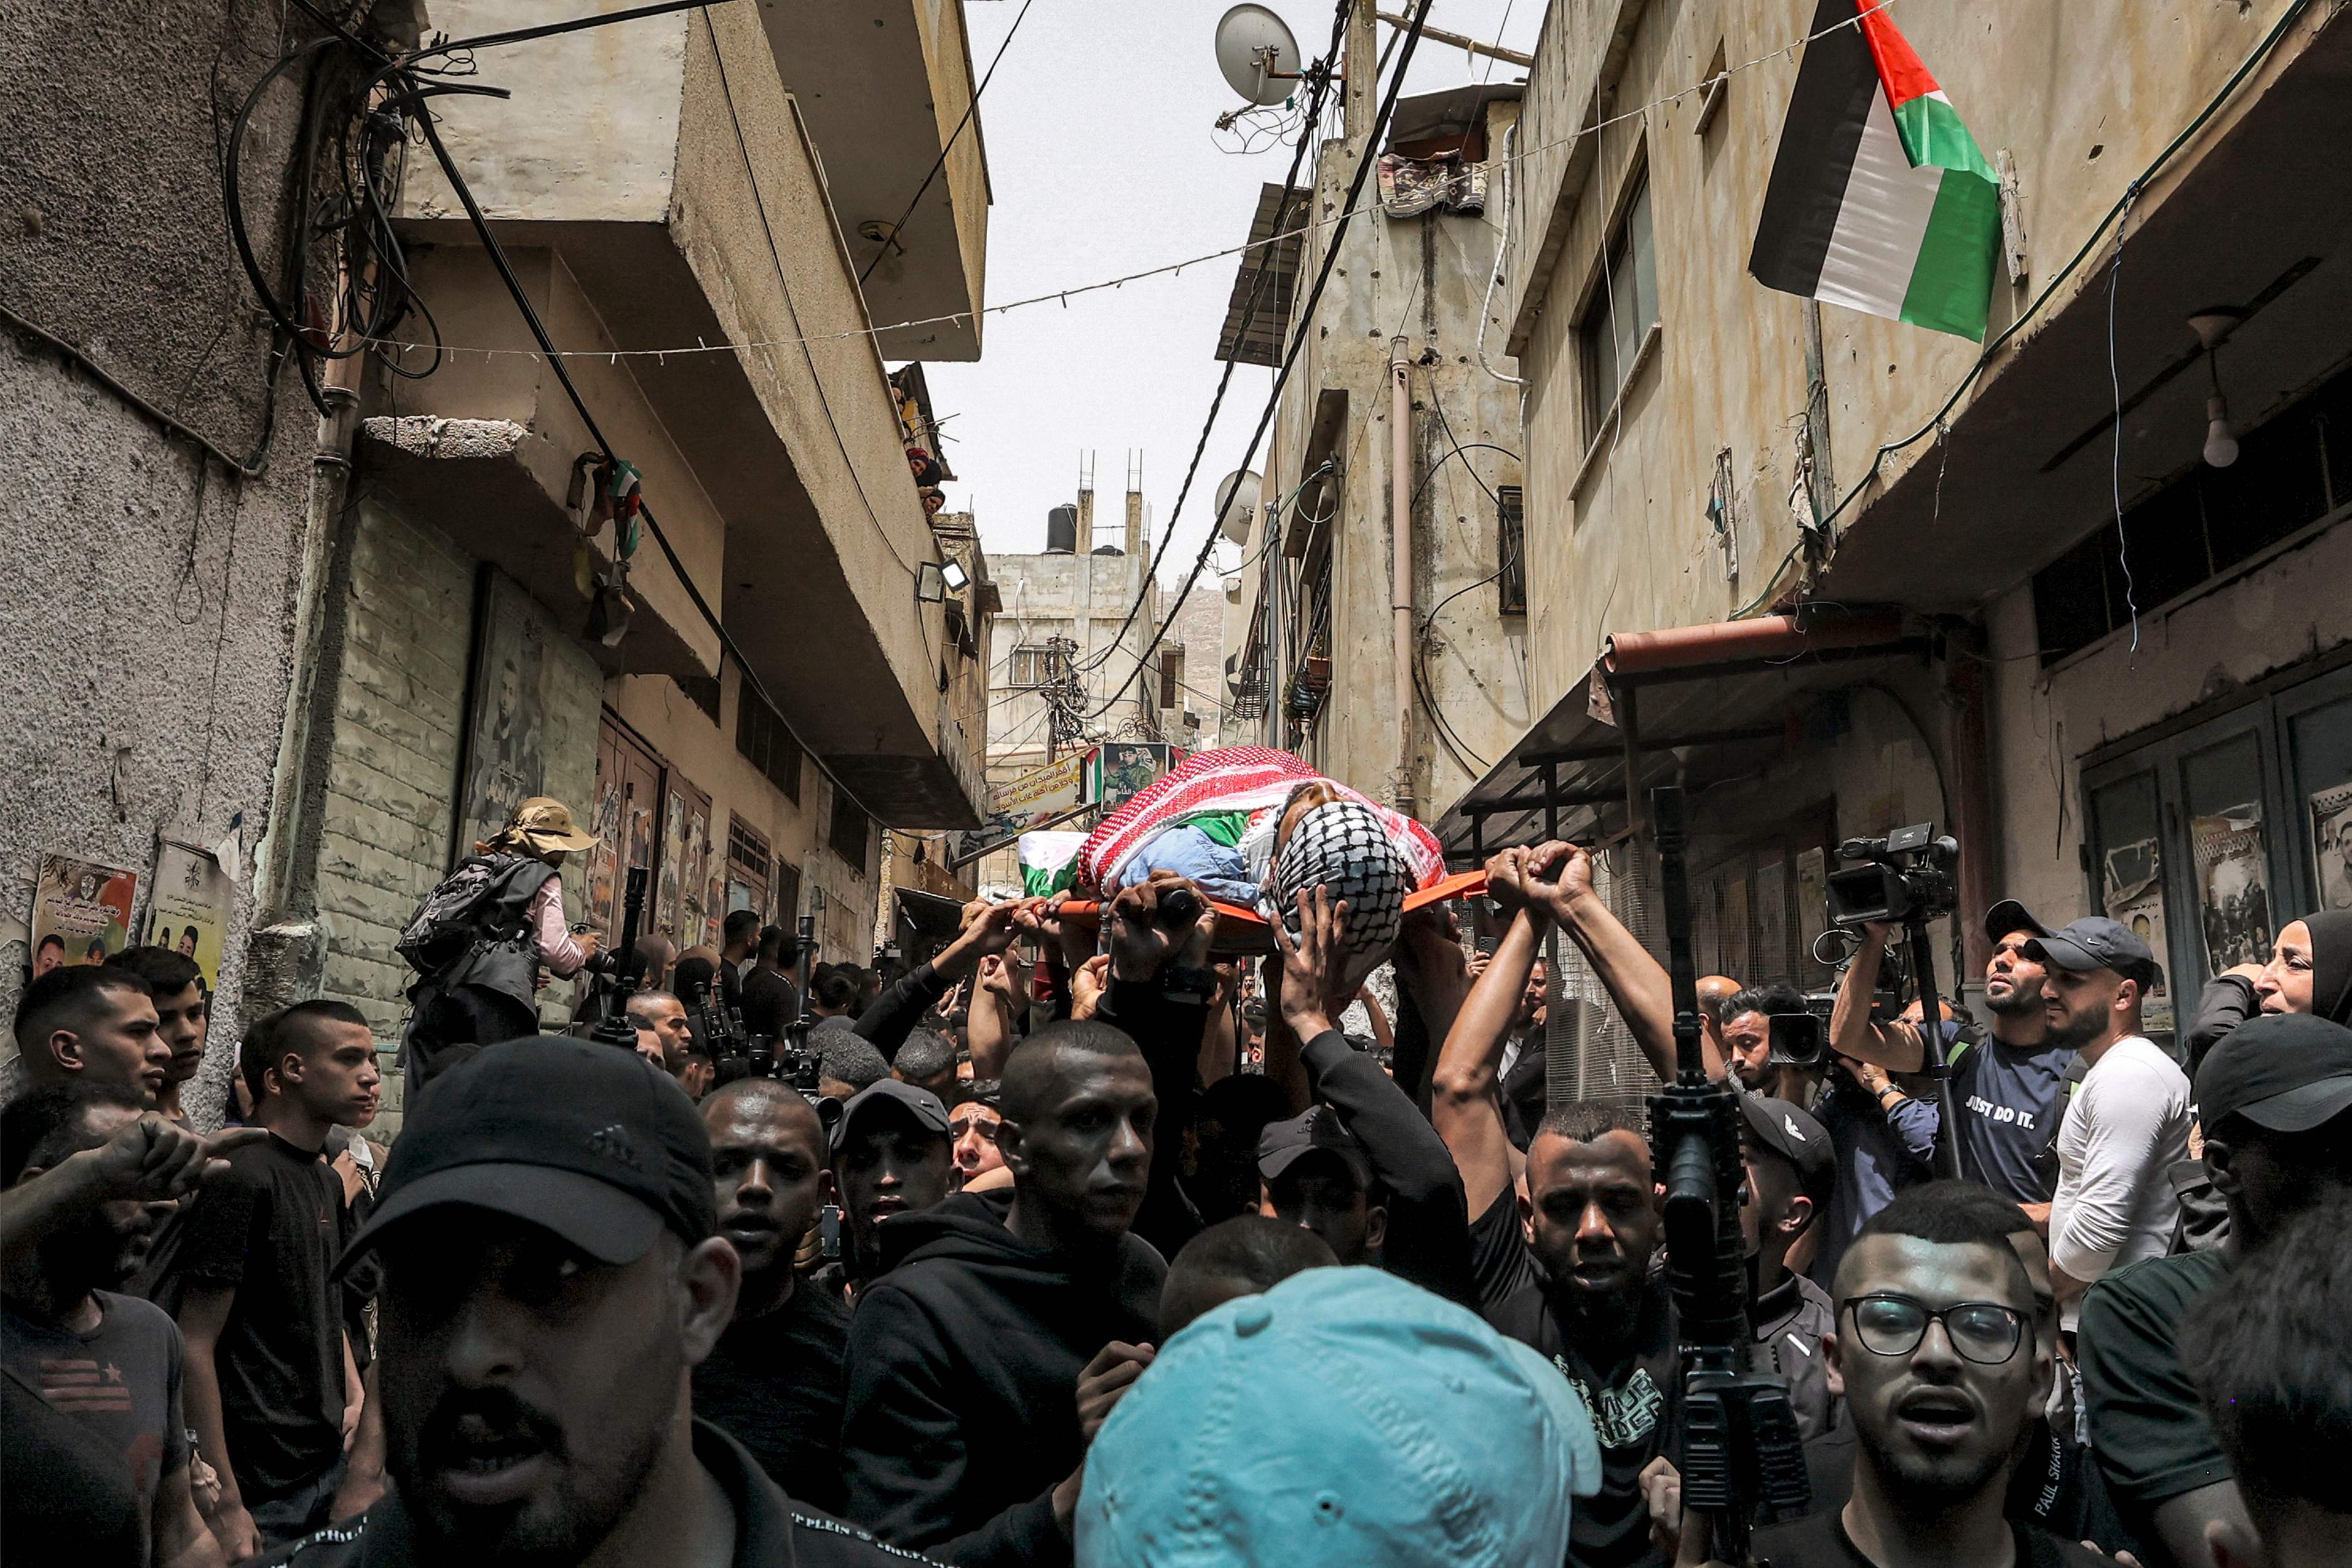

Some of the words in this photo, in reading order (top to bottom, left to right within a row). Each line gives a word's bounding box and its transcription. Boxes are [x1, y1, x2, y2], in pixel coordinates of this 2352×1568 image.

[1018, 783, 1029, 792] من
[1965, 1095, 1994, 1117] JUST
[1993, 1106, 2015, 1123] DO
[2017, 1111, 2035, 1130] IT.
[2035, 1484, 2058, 1517] PAUL
[2048, 1434, 2061, 1481] SHARK
